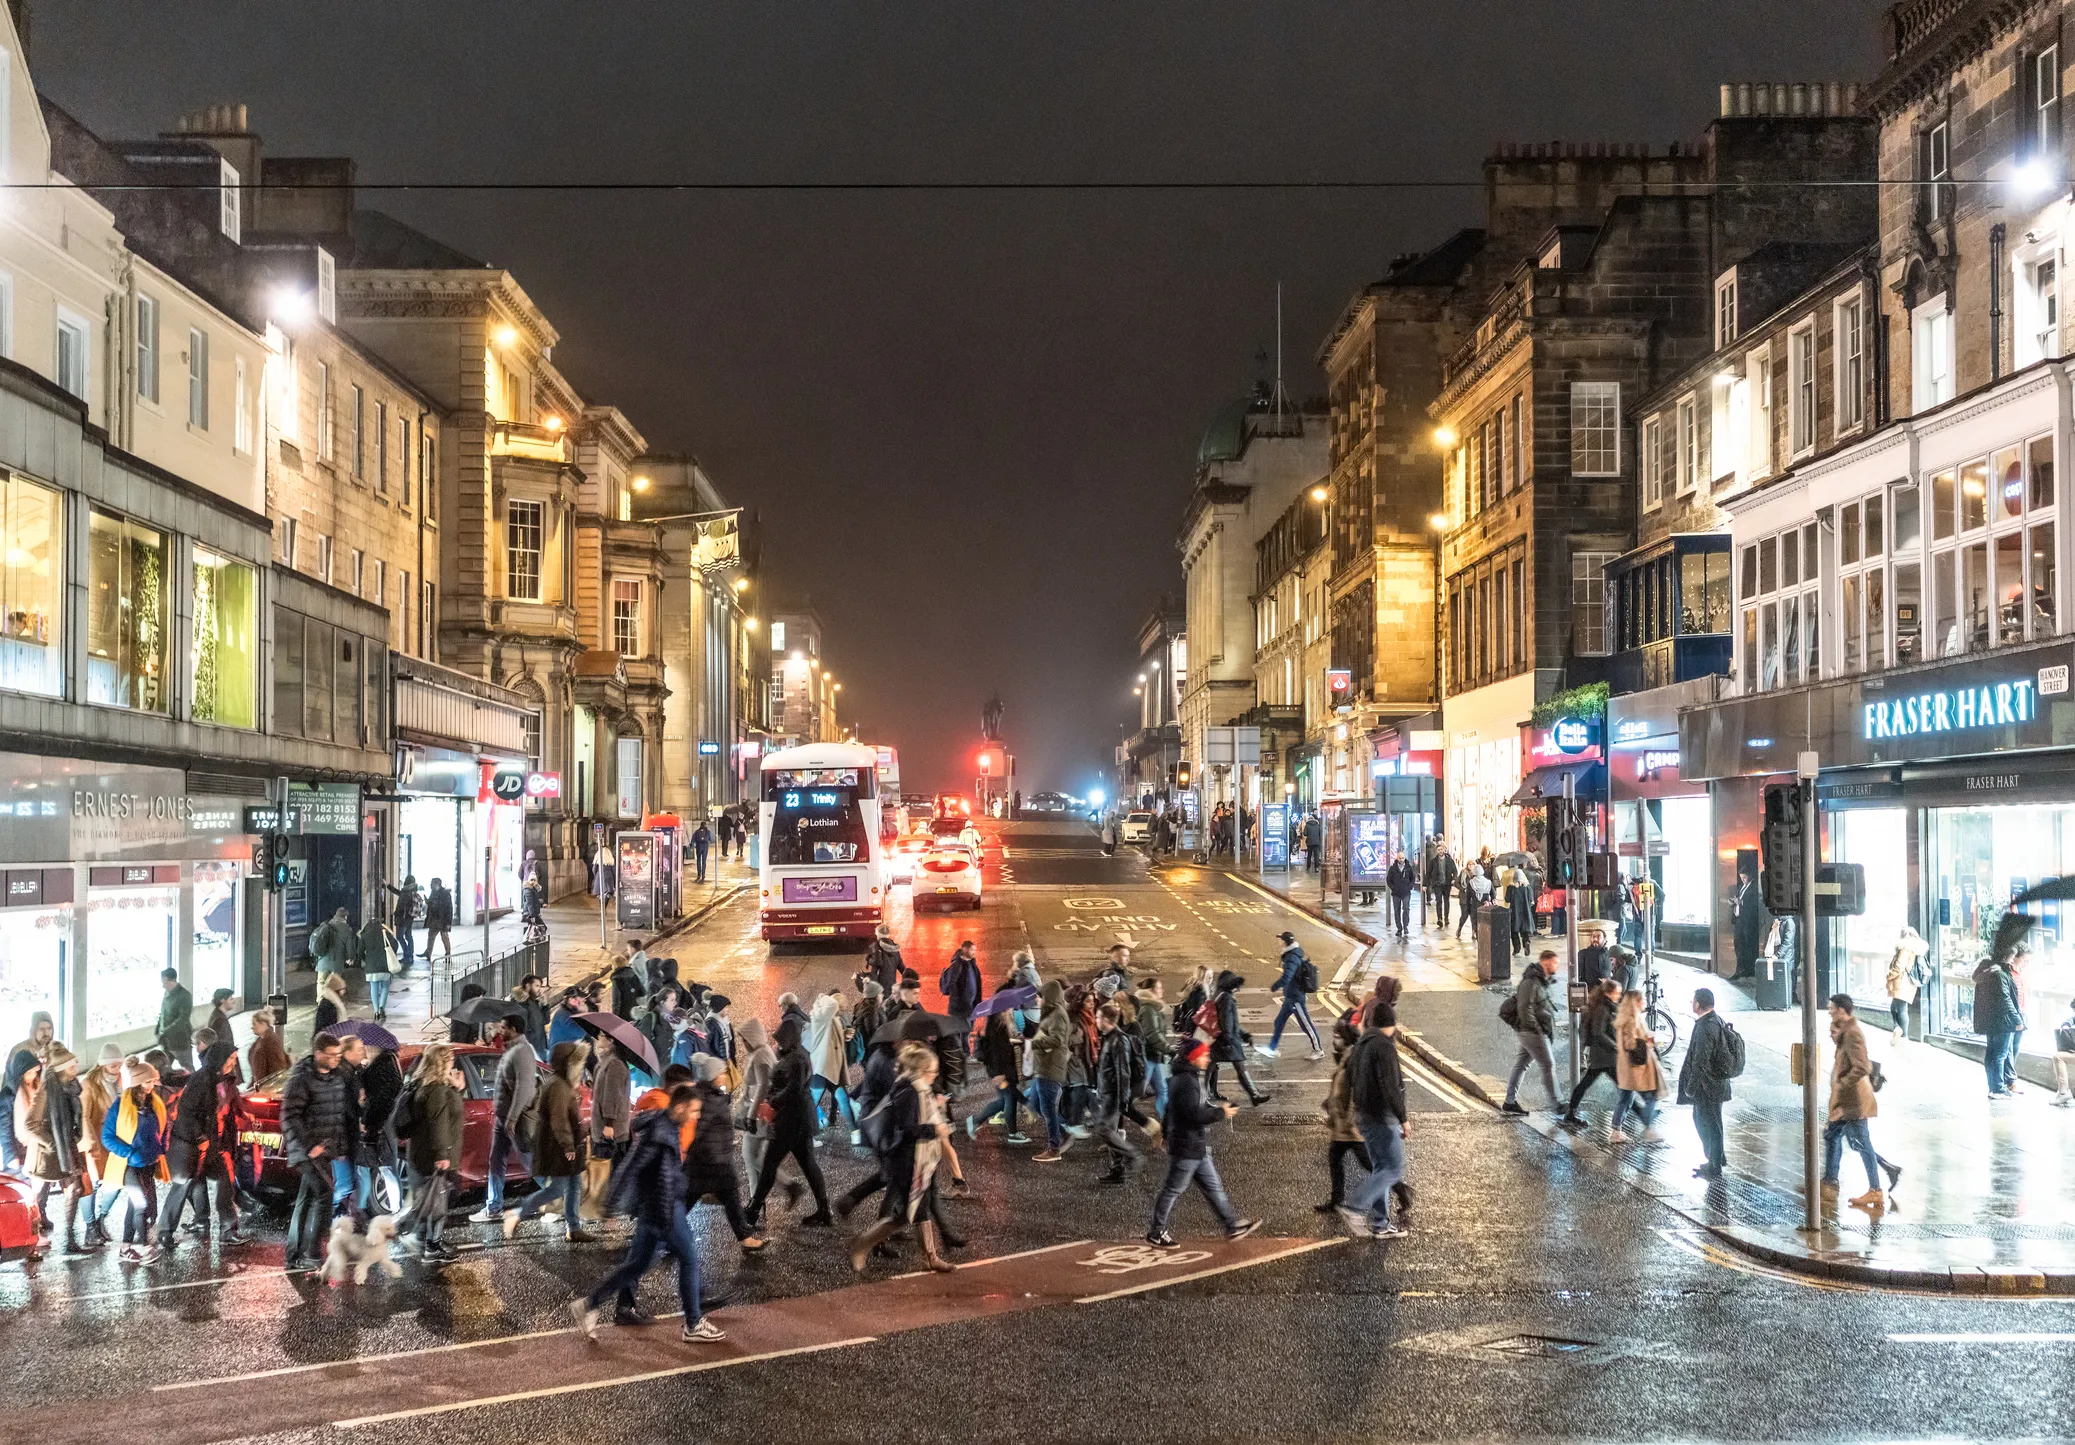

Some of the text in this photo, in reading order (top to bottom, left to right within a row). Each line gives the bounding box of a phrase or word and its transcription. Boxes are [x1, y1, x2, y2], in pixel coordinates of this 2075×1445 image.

[2039, 667, 2066, 681] HANOVER
[2043, 680, 2063, 692] STREET
[1865, 680, 2032, 739] FRASER HART
[1558, 723, 1588, 735] Bella
[1558, 734, 1588, 747] Italia
[497, 775, 522, 793] JD
[1966, 774, 2019, 789] FRASER HART
[1832, 784, 1872, 797] FRASER HART
[73, 791, 139, 818] ERNEST
[148, 796, 194, 820] JONES
[785, 793, 837, 808] 23 Trinity
[315, 804, 332, 813] 182
[333, 804, 357, 814] 8153
[256, 820, 292, 829] JONS
[314, 814, 332, 823] 469
[333, 814, 357, 824] 7666
[809, 818, 839, 827] Lothian
[1213, 907, 1274, 915] BUS
[1065, 915, 1161, 923] ONLY
[1054, 923, 1178, 931] AHEAD
